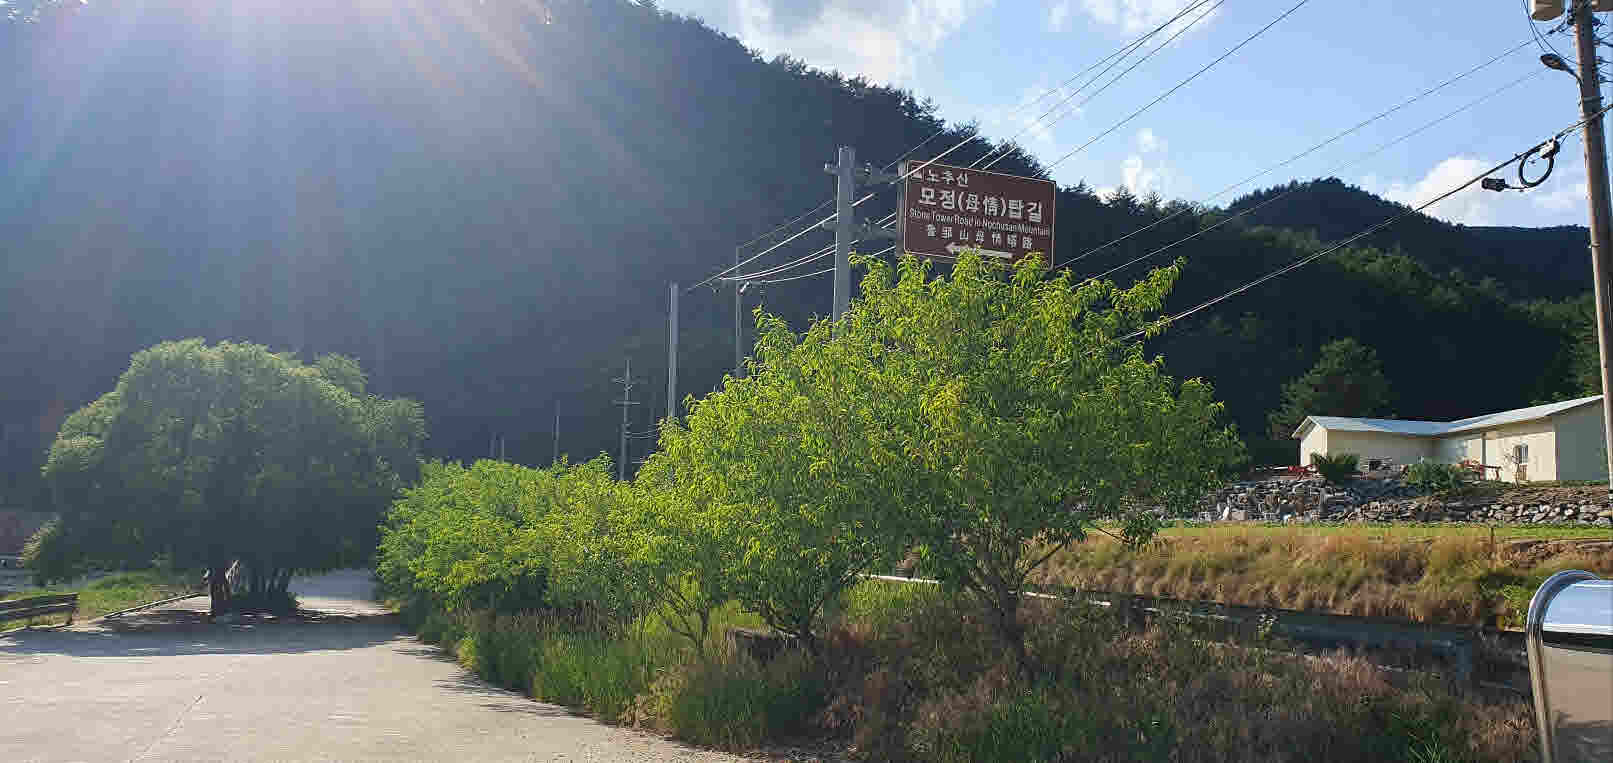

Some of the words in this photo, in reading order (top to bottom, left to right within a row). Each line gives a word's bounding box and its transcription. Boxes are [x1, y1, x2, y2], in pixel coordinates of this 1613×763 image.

[926, 169, 968, 187] 노추산
[909, 208, 930, 220] Stone
[931, 211, 954, 222] Tower
[954, 214, 973, 226] Road
[1018, 222, 1049, 237] Mountain
